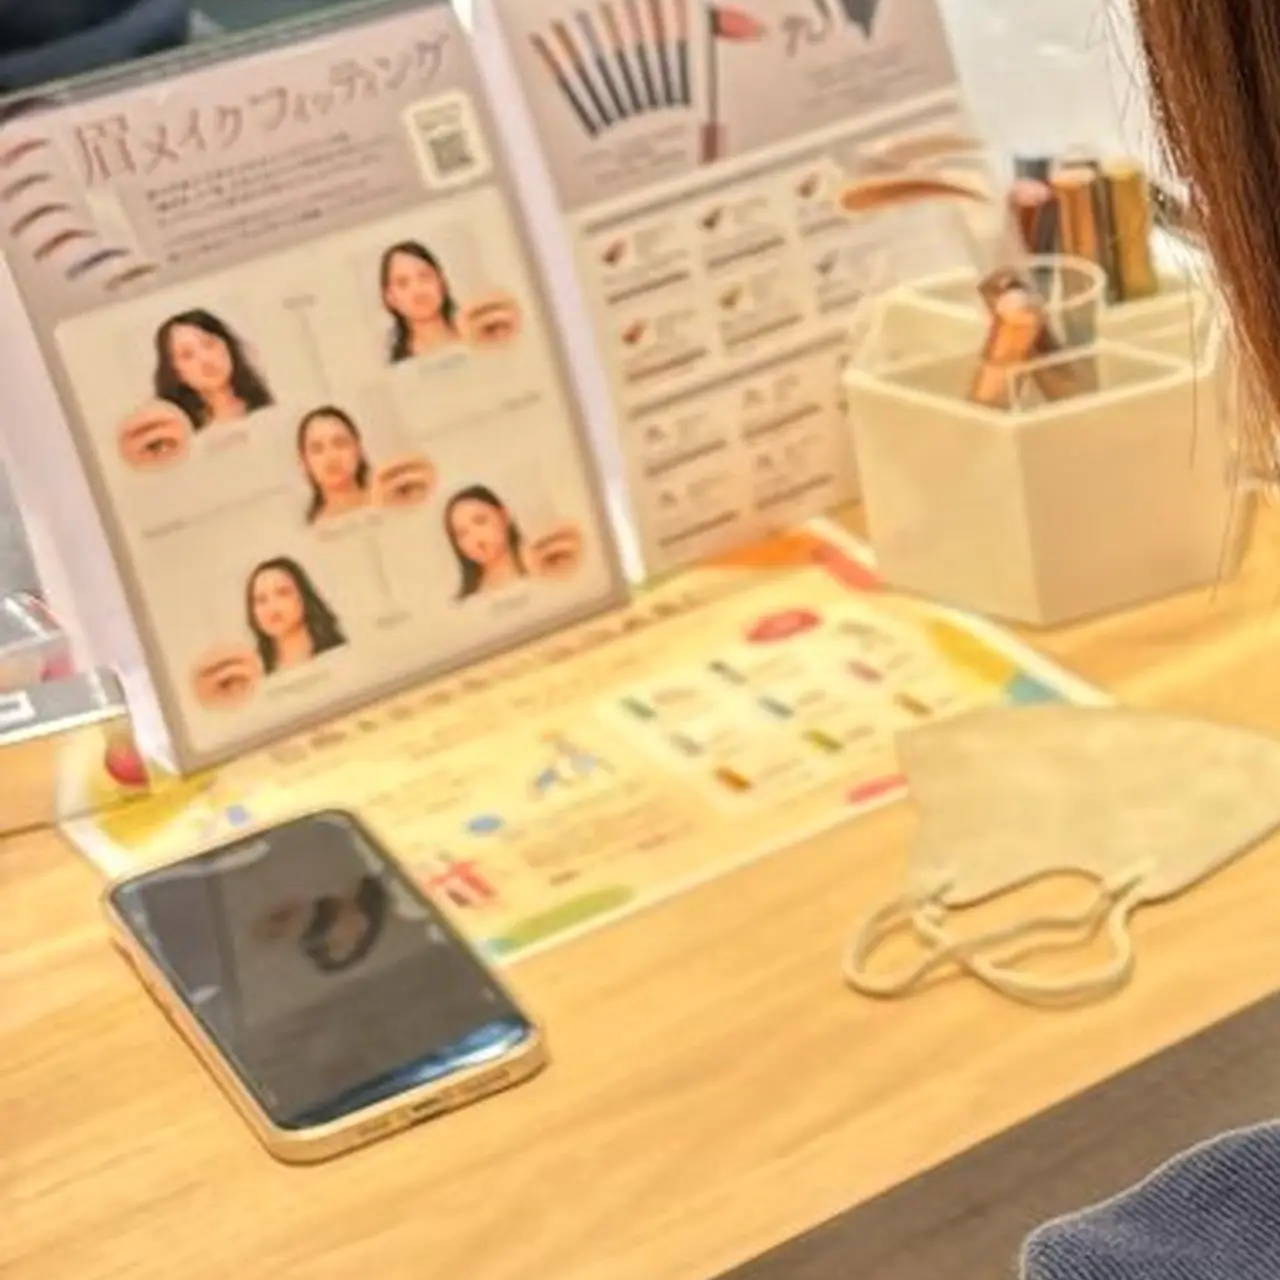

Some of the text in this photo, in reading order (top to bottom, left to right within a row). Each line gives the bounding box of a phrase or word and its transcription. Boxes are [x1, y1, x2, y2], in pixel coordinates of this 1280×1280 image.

[74, 34, 450, 186] 眉メイクフィッティング
